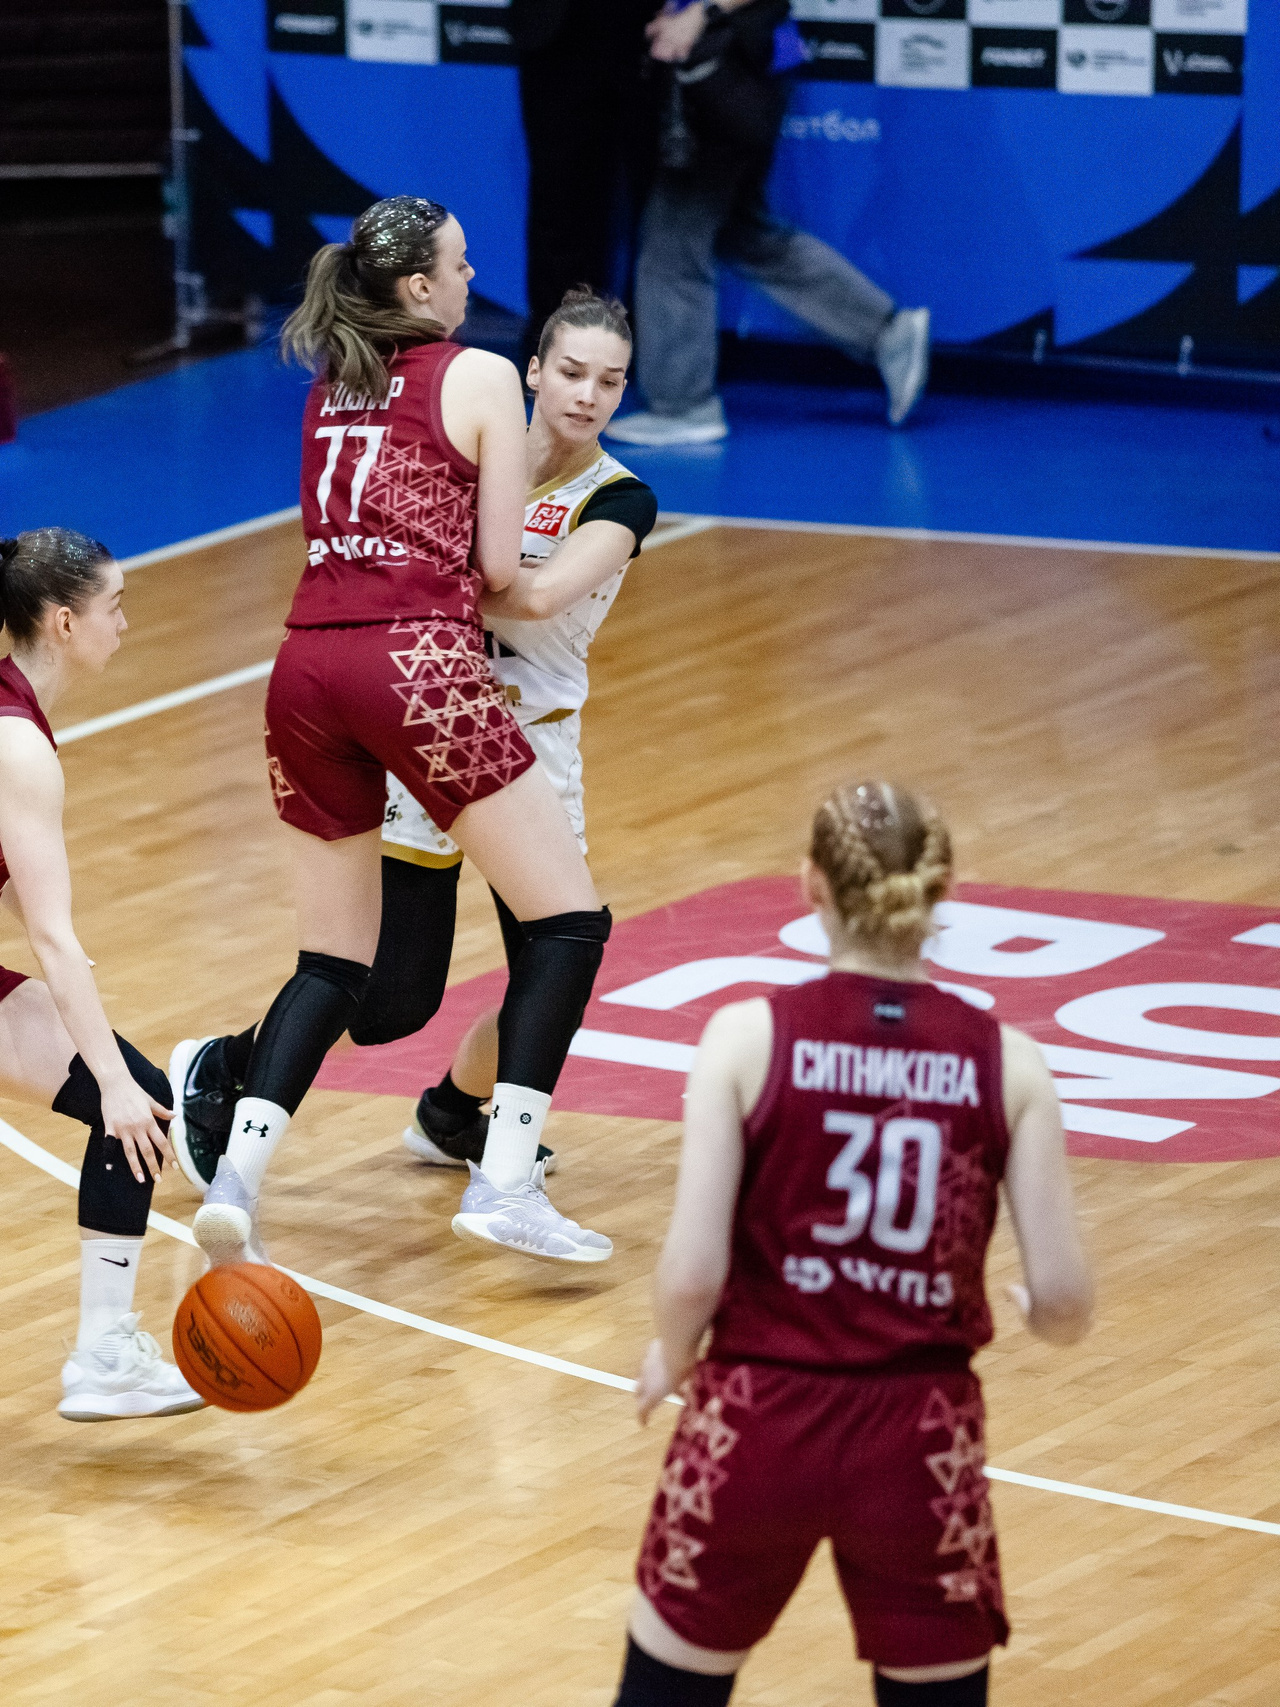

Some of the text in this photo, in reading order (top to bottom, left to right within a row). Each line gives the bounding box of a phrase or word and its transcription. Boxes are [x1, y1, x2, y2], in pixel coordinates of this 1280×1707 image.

[314, 425, 386, 524] 77
[527, 517, 560, 531] BET
[793, 1038, 980, 1108] СИТНИКОВА
[811, 1109, 942, 1254] 30
